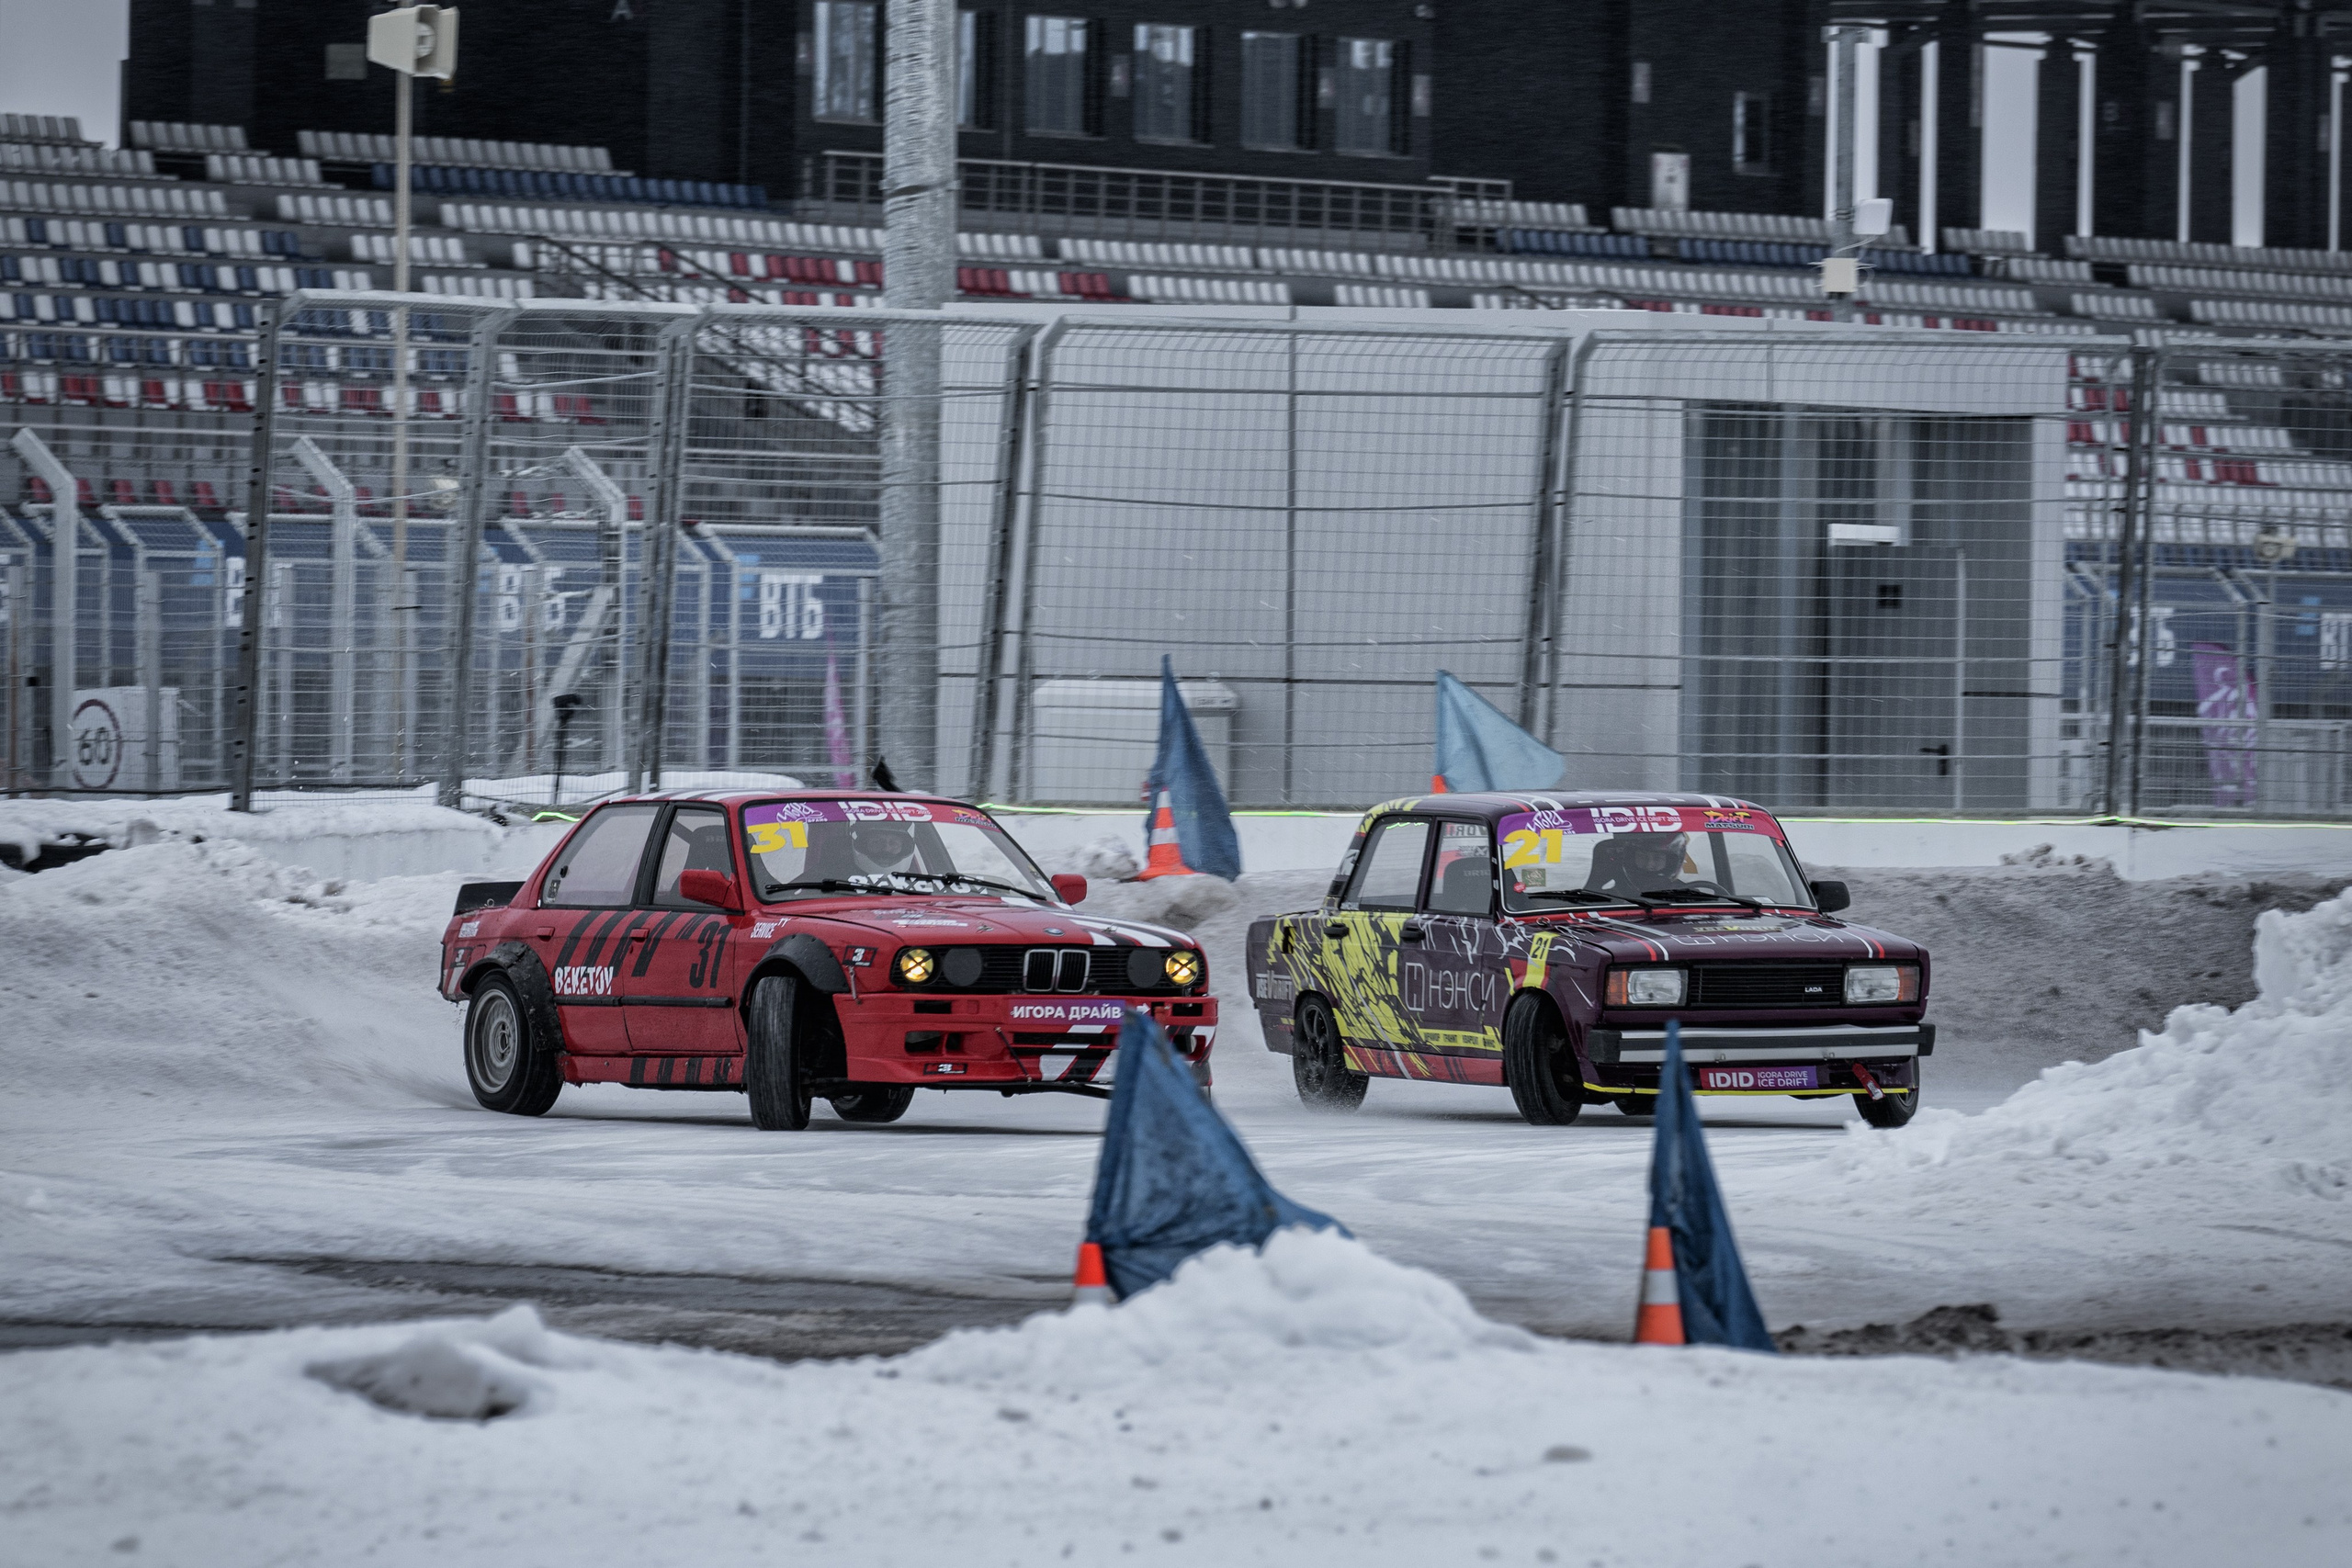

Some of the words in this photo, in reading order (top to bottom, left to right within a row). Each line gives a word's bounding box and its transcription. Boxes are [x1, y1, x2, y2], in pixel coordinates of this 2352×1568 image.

[759, 574, 824, 639] ВТБ
[79, 727, 111, 765] 60
[747, 820, 808, 854] 31
[1503, 829, 1564, 871] 21
[689, 921, 733, 989] 31
[1531, 937, 1549, 960] 21
[555, 965, 614, 996] BEKETOV
[1429, 969, 1496, 1012] НЭНСИ
[1012, 1006, 1066, 1019] ИГОРА
[1068, 1003, 1122, 1021] ДРАЙВ
[1708, 1071, 1755, 1088] IDID
[1758, 1078, 1776, 1088] ICE
[1777, 1077, 1809, 1088] DRIFT
[1784, 1070, 1808, 1078] DRIVE
